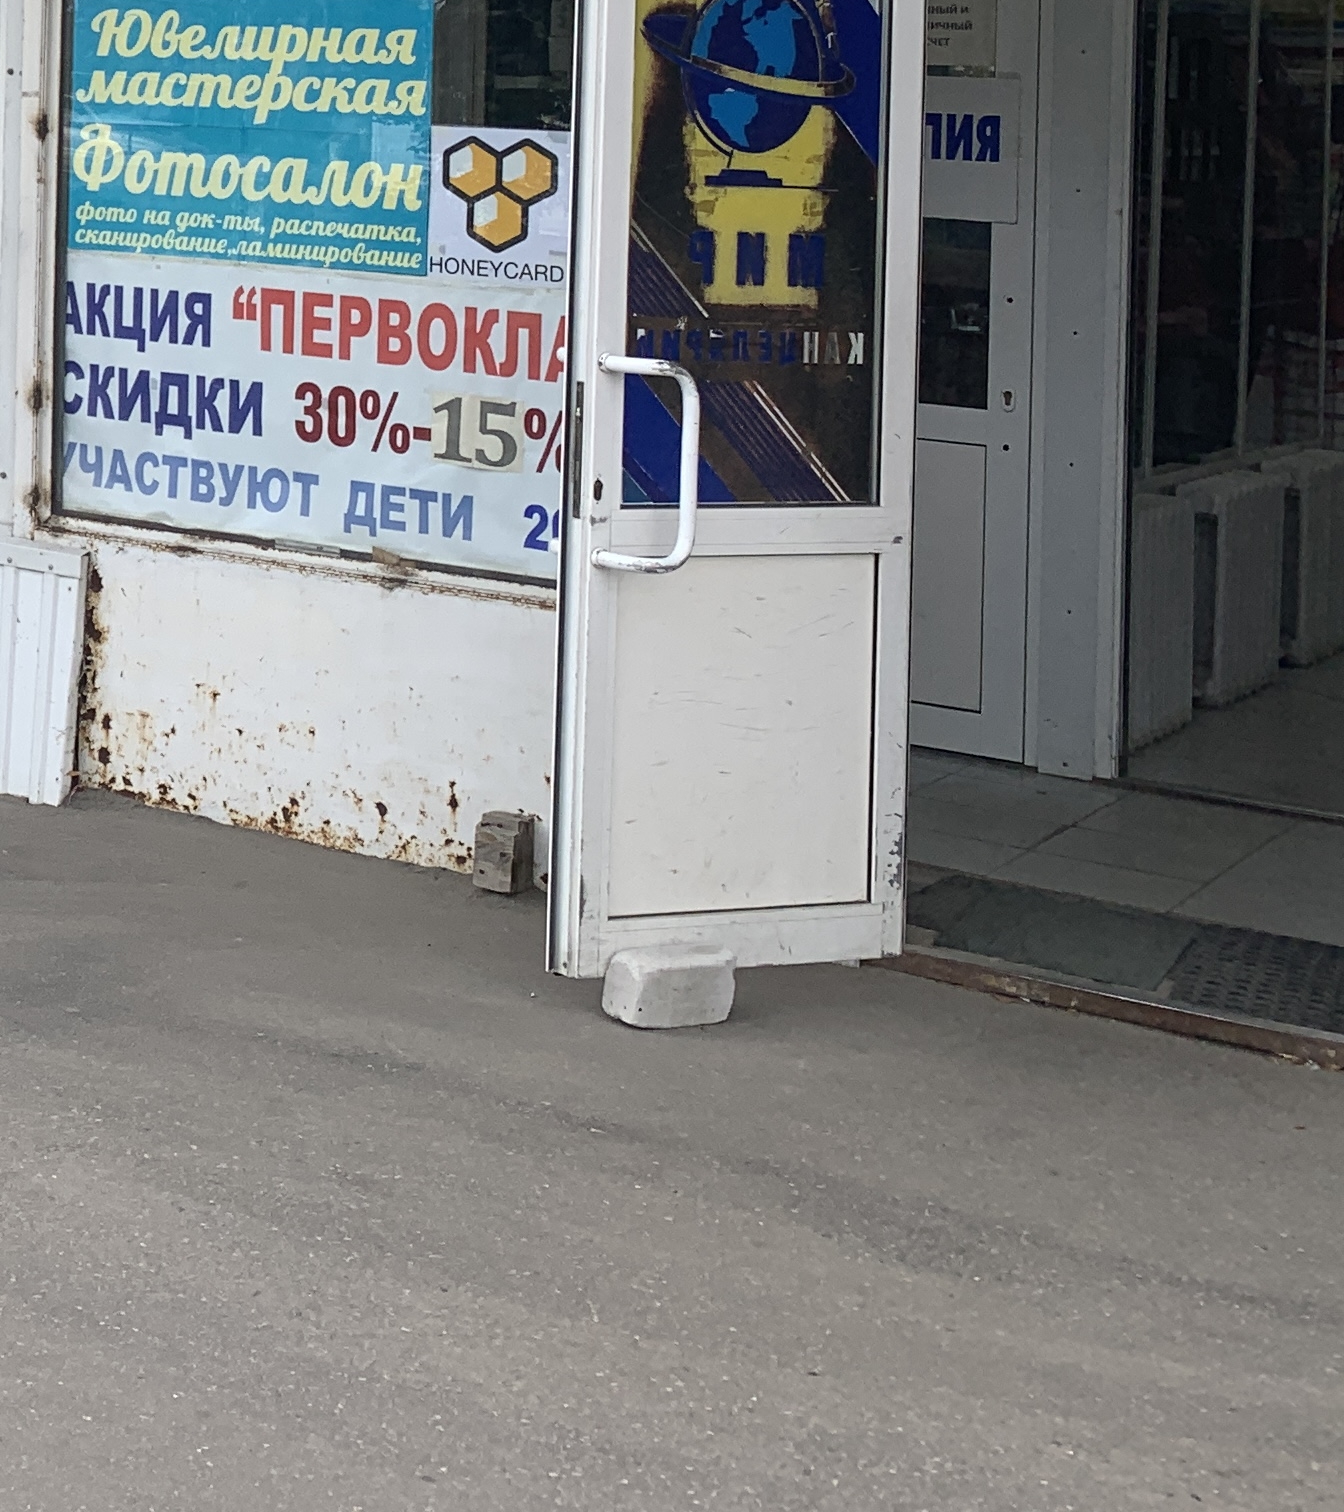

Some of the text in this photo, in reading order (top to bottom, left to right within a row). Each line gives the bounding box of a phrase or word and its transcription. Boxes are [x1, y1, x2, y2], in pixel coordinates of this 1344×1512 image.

[91, 8, 417, 75] Ювелирная
[927, 37, 950, 47] ЧЕТ
[76, 70, 427, 125] мастерская
[73, 123, 423, 212] Фотосалон
[76, 201, 137, 224] фото
[143, 208, 170, 226] на
[271, 216, 422, 245] распечатка,
[430, 257, 564, 283] HONEYCARD
[64, 360, 263, 440] СКИДКИ
[343, 480, 473, 541] ДЕТИ
[523, 504, 559, 552] 2
